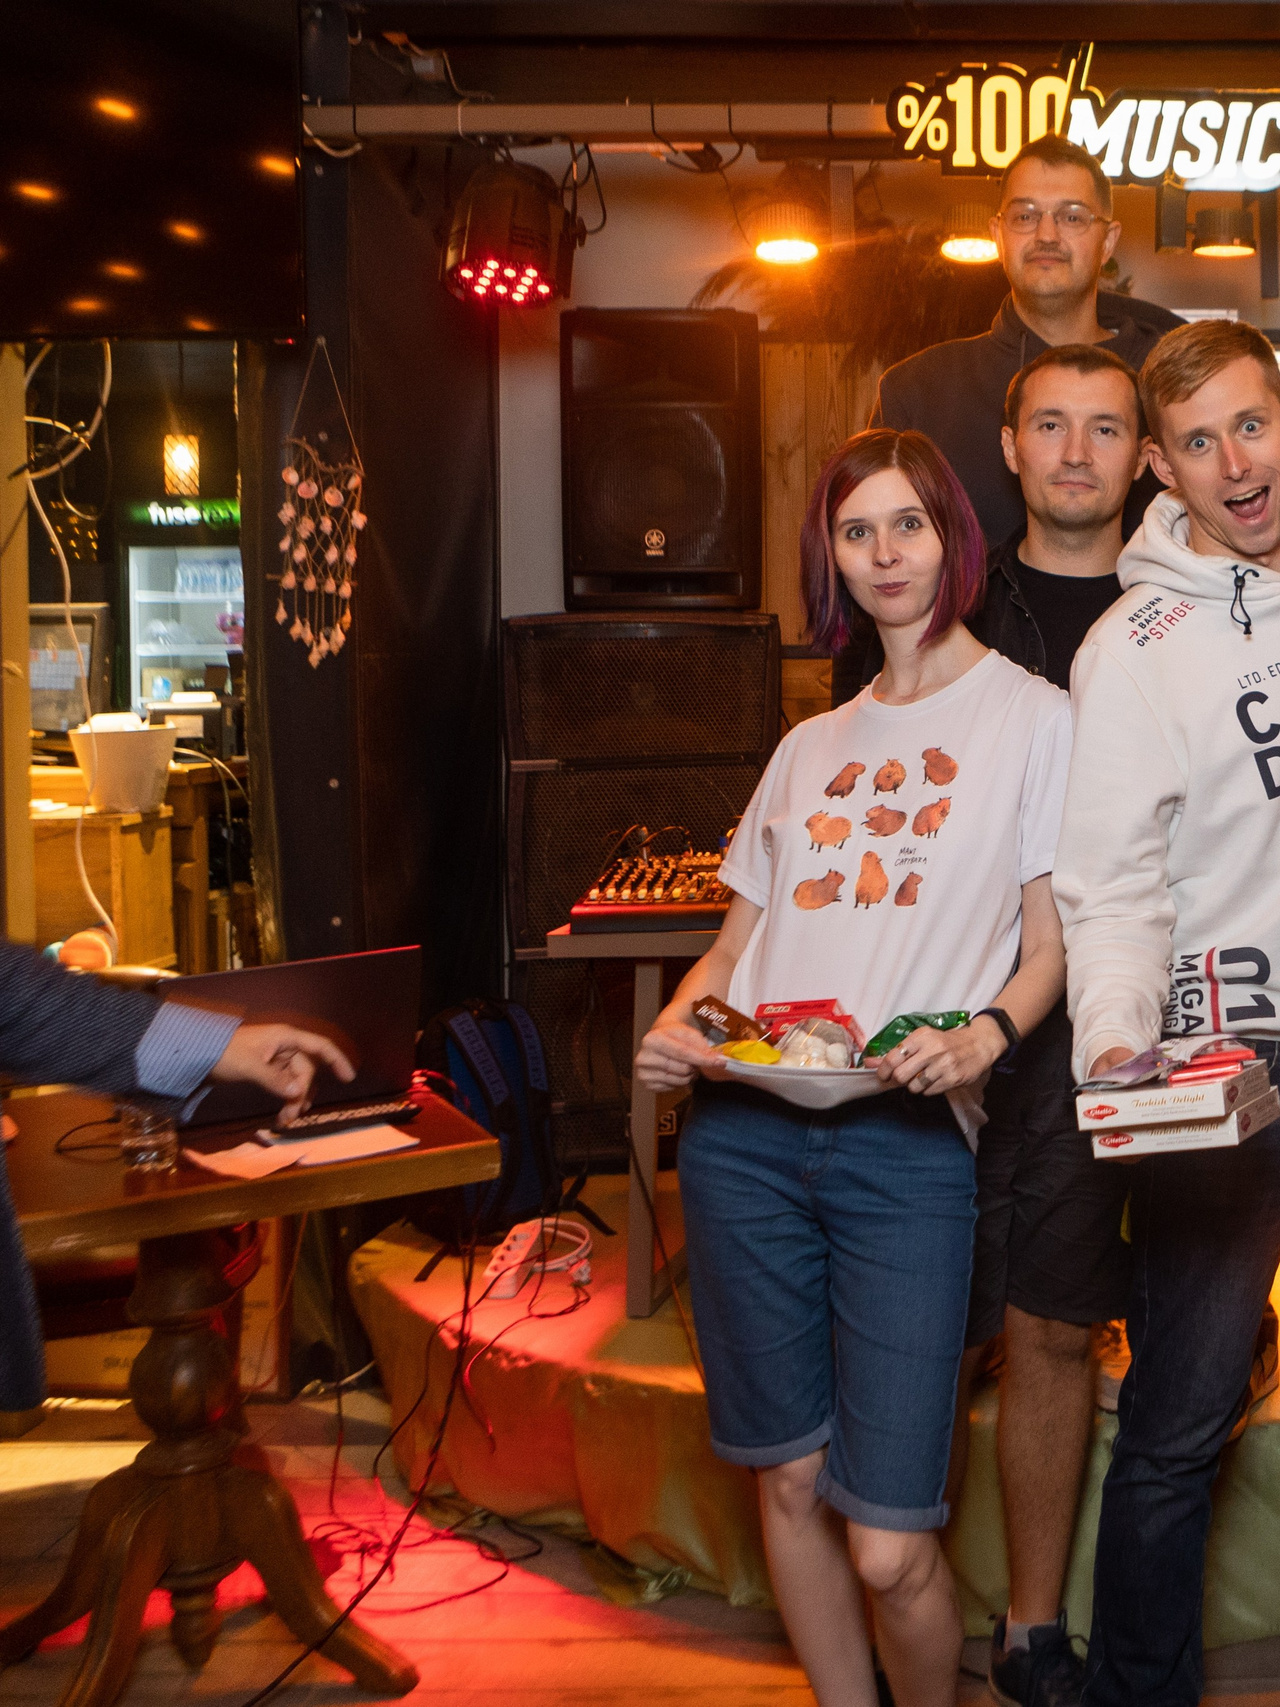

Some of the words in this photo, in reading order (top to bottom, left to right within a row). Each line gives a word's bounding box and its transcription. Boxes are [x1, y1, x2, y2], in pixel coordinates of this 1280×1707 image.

[1128, 596, 1163, 623] RETURN
[1138, 608, 1163, 629] BACK
[1136, 633, 1151, 647] ON
[1148, 600, 1196, 640] STAGE
[1237, 672, 1266, 690] LTD.
[1174, 952, 1205, 1035] MEGA
[1131, 1097, 1167, 1108] Turkish
[1170, 1093, 1206, 1105] Delight
